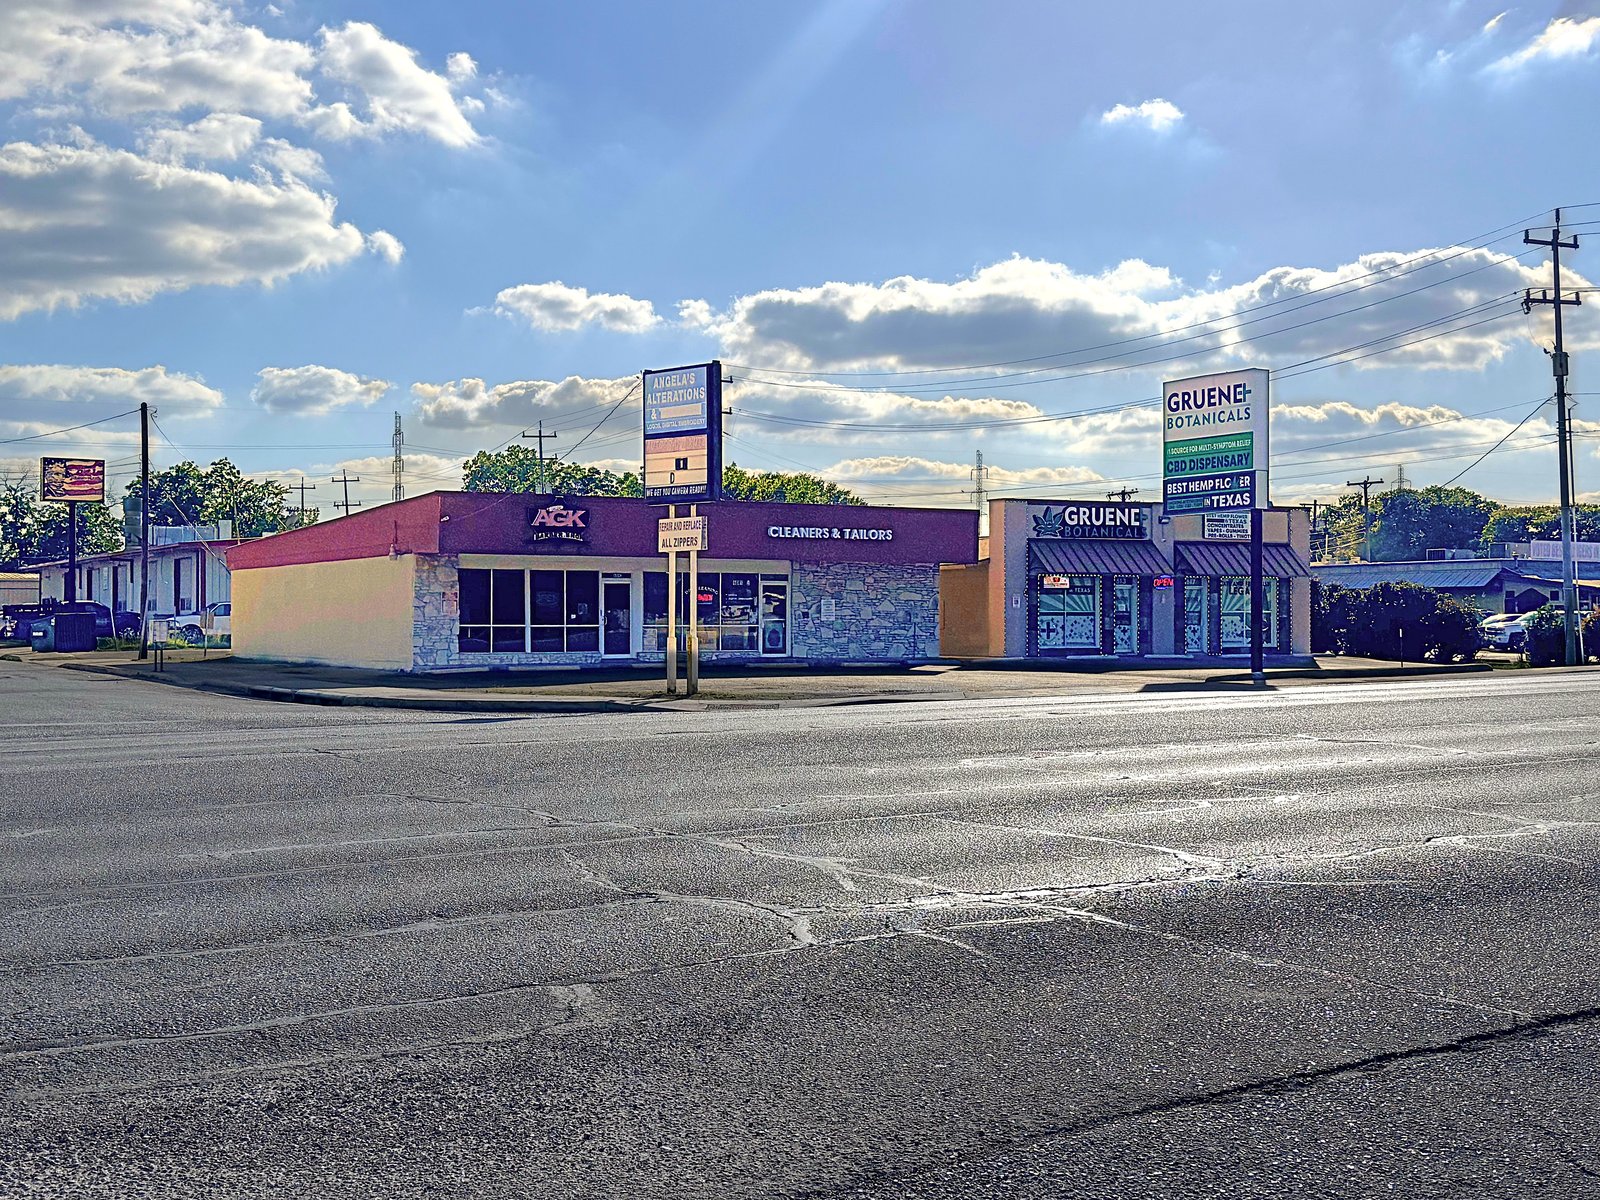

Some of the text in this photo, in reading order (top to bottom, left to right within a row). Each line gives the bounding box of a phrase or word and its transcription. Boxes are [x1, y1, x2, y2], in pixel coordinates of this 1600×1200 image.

[653, 373, 695, 389] ANGELA'S
[646, 387, 705, 405] ALTERATIONS
[650, 408, 657, 420] &
[1167, 407, 1251, 429] BOTANICALS
[1167, 452, 1250, 473] CBD DISPENSARY
[653, 488, 662, 496] GET
[1167, 475, 1251, 494] BEST HEMP FLOER
[1212, 492, 1251, 507] TEXAS
[531, 508, 586, 527] AGK
[768, 526, 893, 540] CLEANERS & TAILORS
[1064, 526, 1148, 538] BOTANICALS
[661, 536, 698, 548] ALL ZIPPERS
[1551, 542, 1563, 558] BES
[1153, 578, 1174, 587] OPEN
[1229, 586, 1251, 596] LEGA
